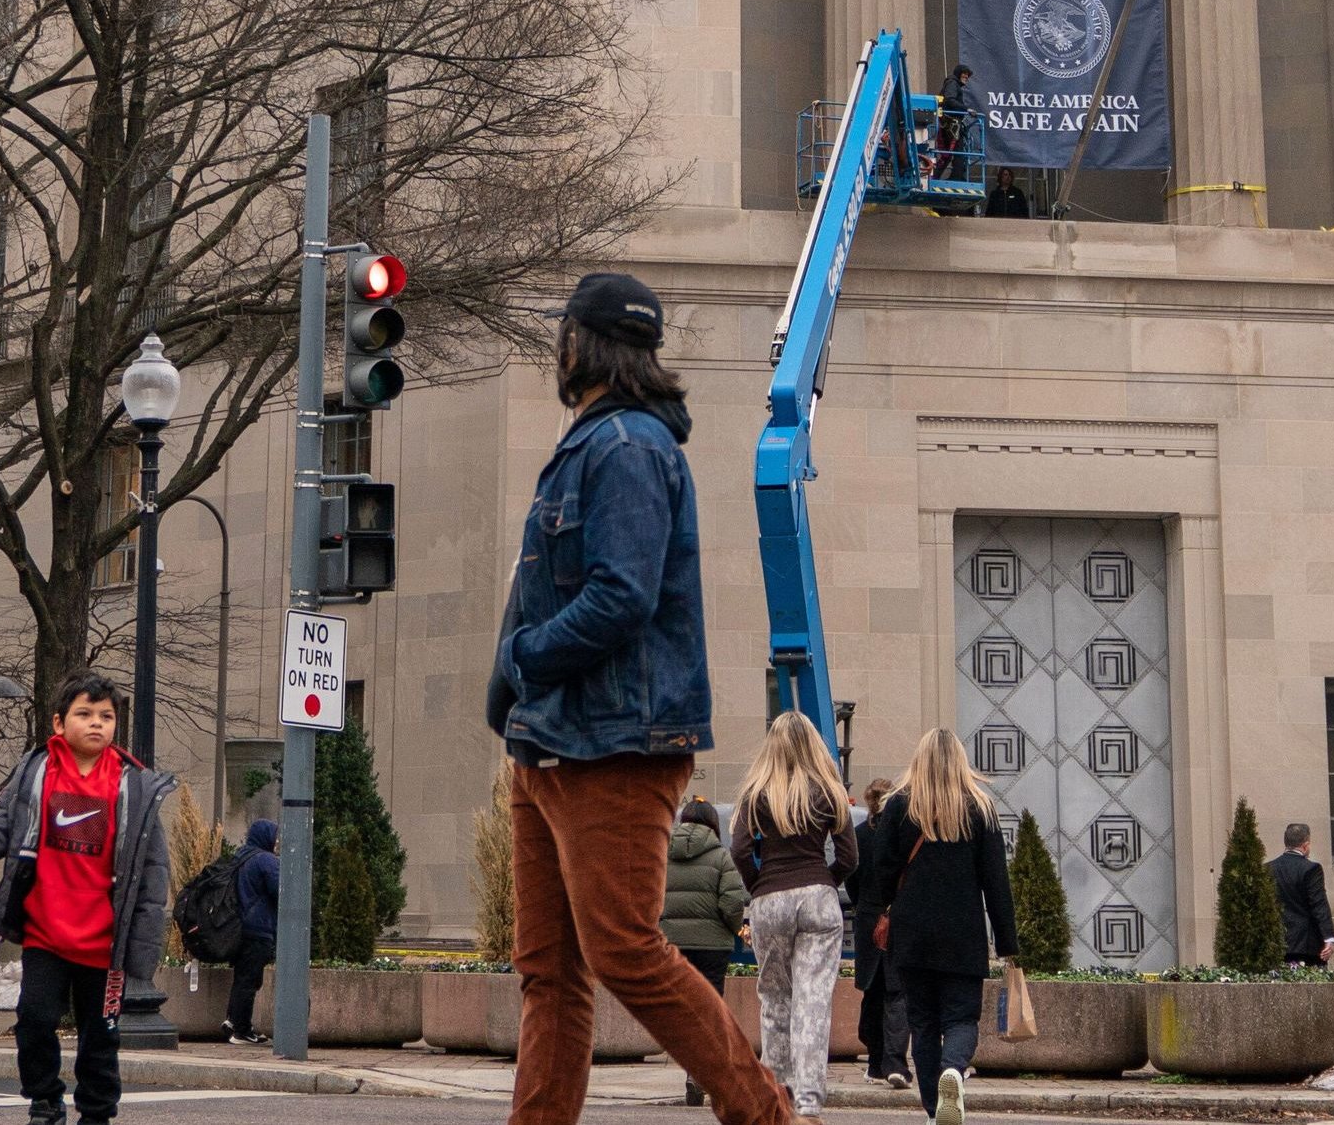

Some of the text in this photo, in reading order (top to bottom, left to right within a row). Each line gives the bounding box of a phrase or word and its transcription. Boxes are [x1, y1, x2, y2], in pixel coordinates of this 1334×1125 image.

[1081, 0, 1103, 40] JUSTICE
[988, 92, 1045, 108] MAKE
[989, 111, 1052, 131] SAFE
[303, 621, 329, 644] NO
[298, 648, 332, 668] TURN
[289, 670, 339, 692] ON RED
